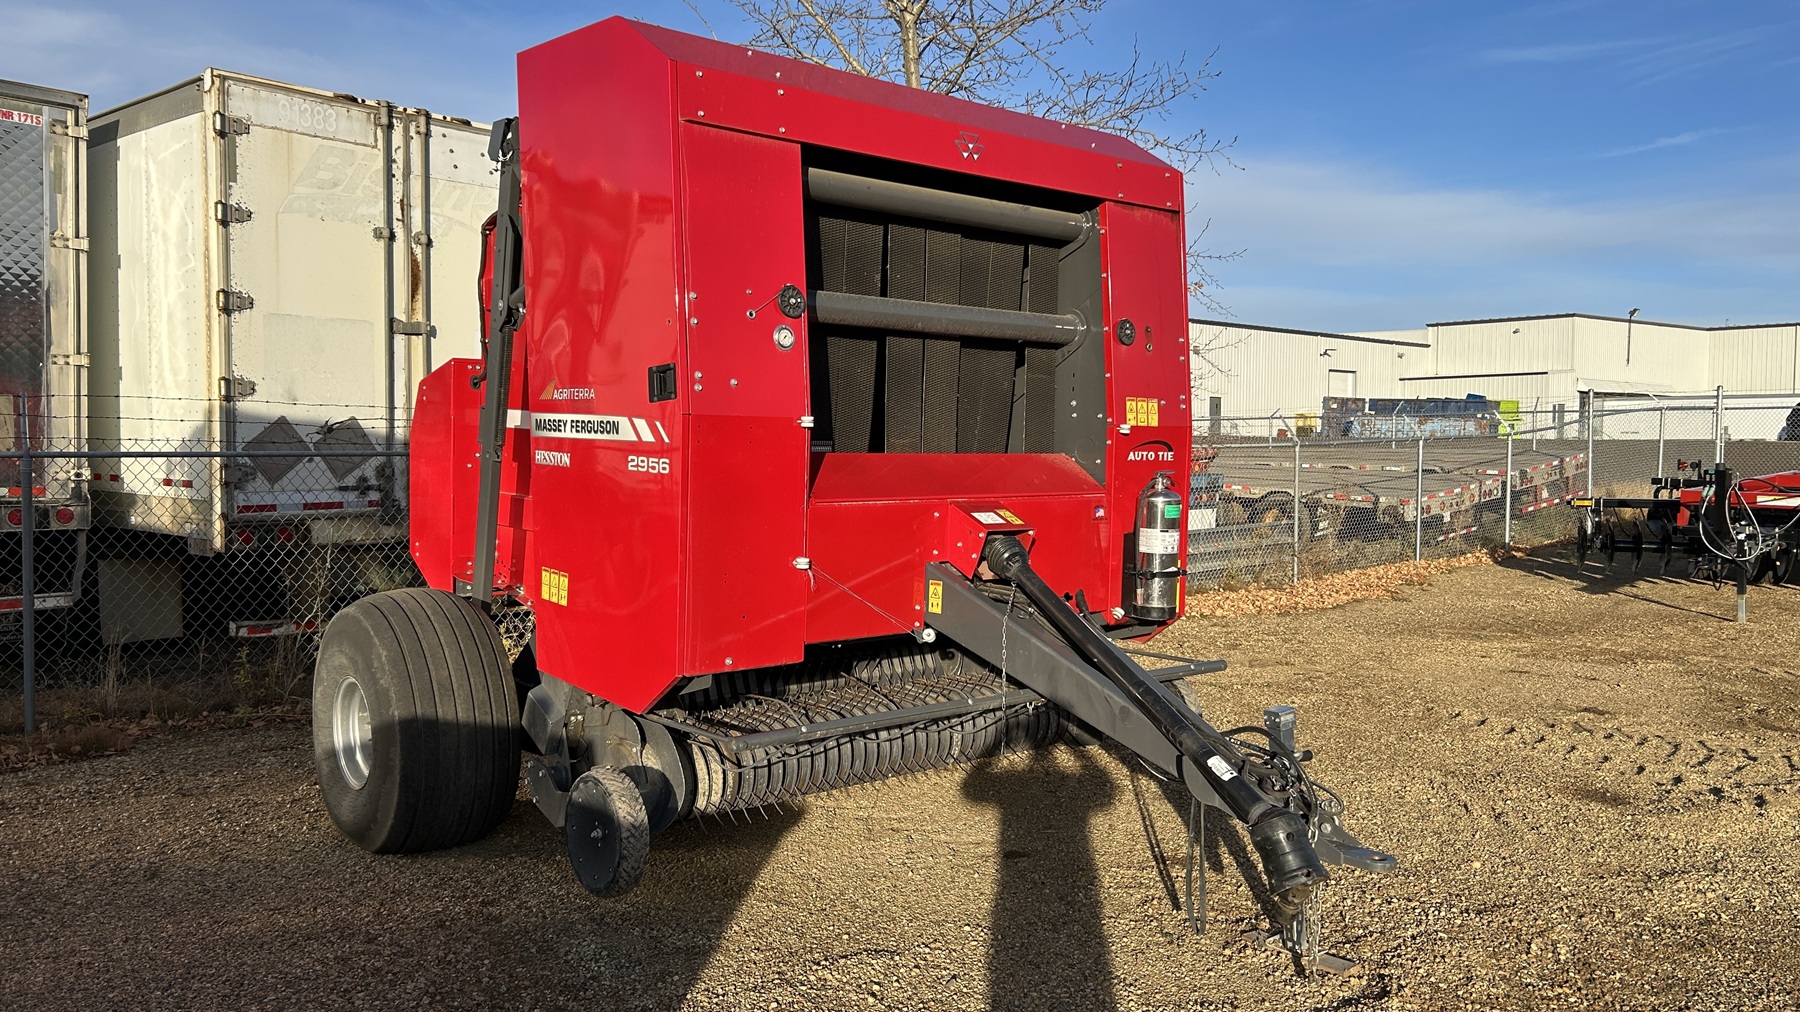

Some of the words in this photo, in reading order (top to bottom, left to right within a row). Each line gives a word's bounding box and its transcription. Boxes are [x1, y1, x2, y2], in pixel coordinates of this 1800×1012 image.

[279, 100, 337, 132] 91383
[553, 388, 595, 400] AGRITERRA
[535, 418, 568, 433] MASSEY
[570, 419, 620, 435] FERGUSON
[535, 450, 571, 467] HESSTON
[1127, 451, 1155, 461] AUTO
[1157, 451, 1175, 461] TIE
[627, 456, 670, 474] 2956
